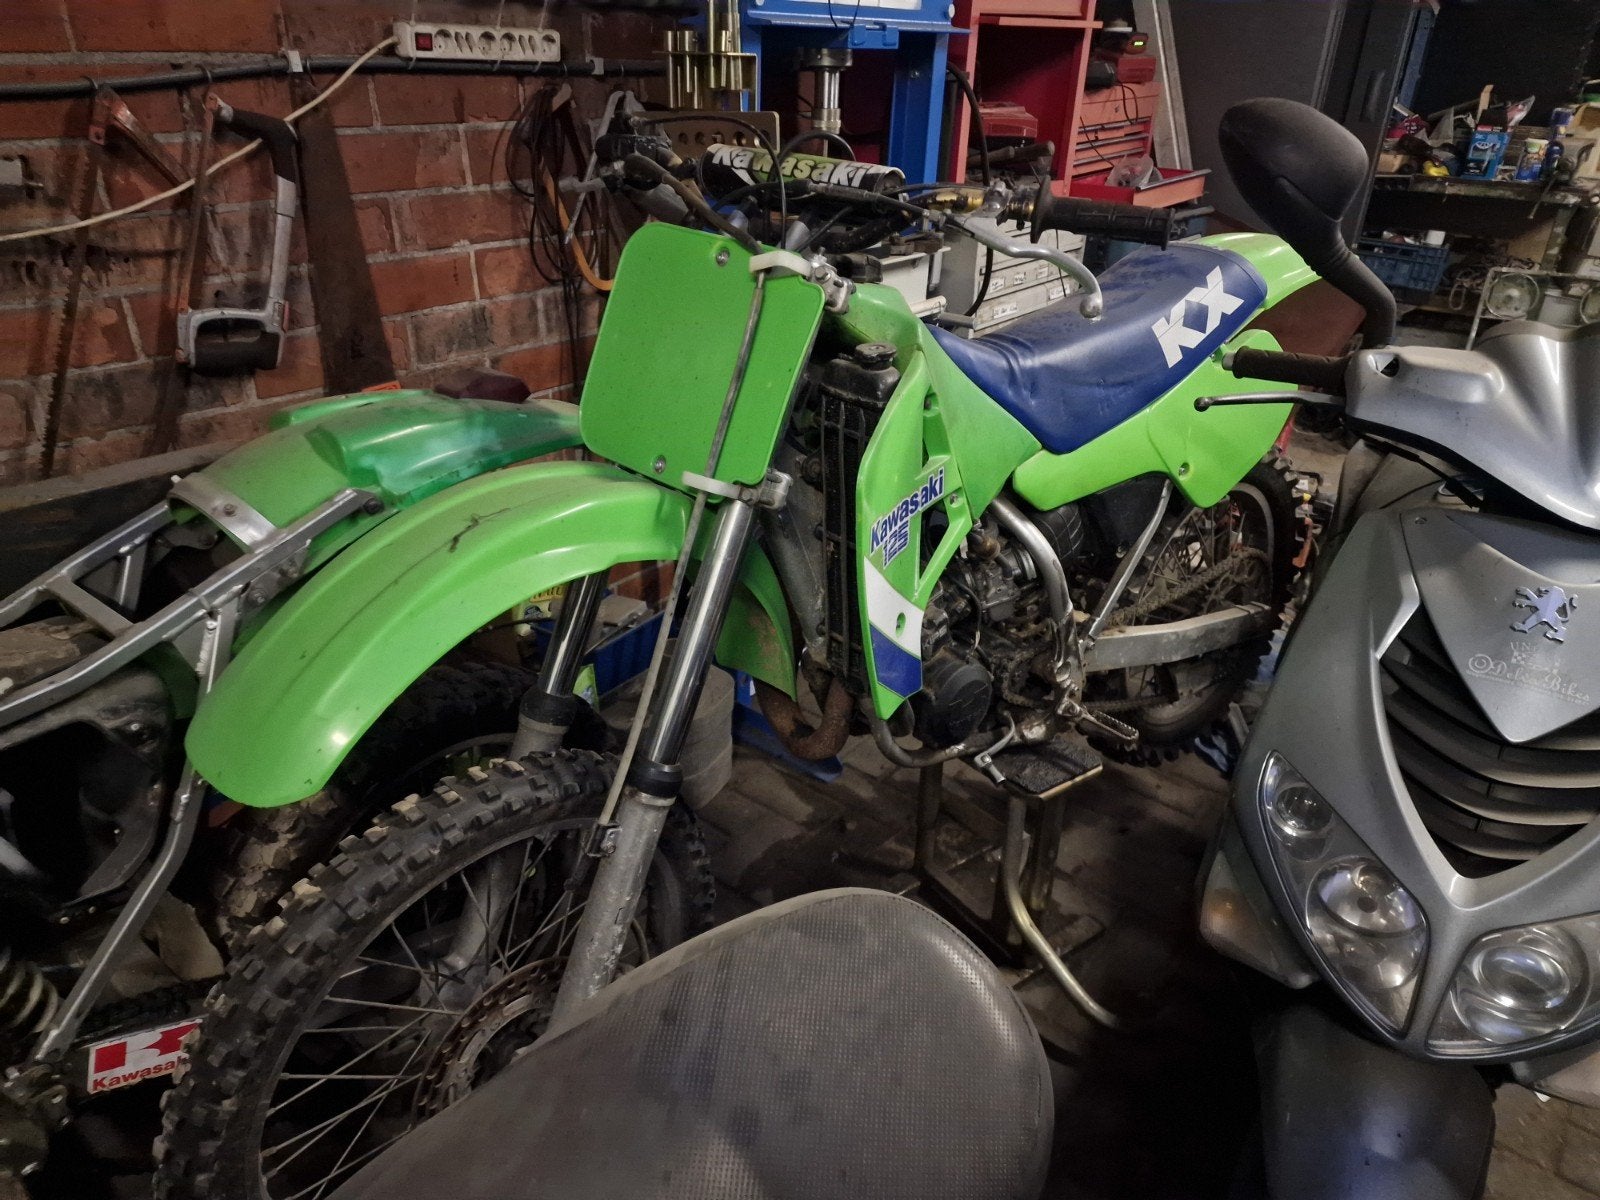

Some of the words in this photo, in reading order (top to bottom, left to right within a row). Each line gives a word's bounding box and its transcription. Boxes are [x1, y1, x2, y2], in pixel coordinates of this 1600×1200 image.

[1151, 265, 1245, 369] KX
[870, 466, 945, 556] Kawasaki
[883, 519, 910, 568] 125
[1543, 672, 1590, 701] Bikes
[92, 1055, 188, 1092] Kawasak
